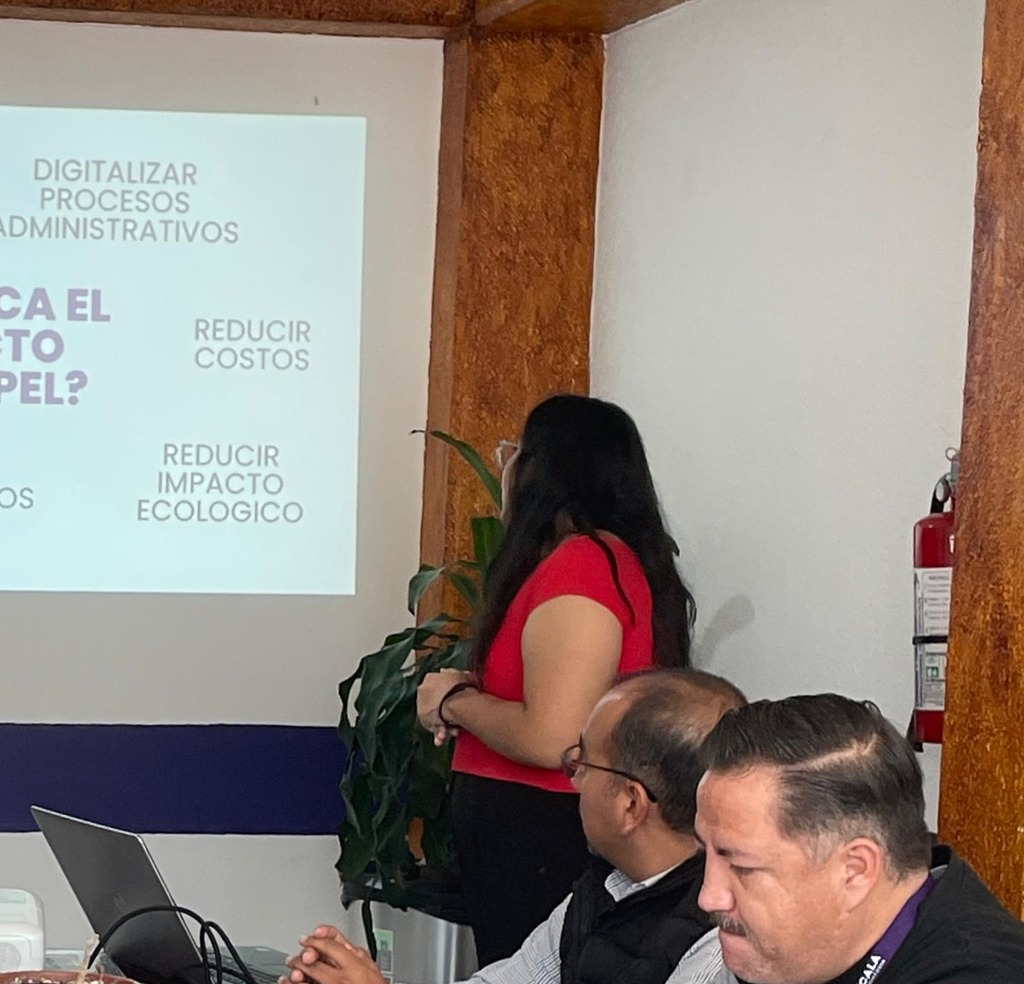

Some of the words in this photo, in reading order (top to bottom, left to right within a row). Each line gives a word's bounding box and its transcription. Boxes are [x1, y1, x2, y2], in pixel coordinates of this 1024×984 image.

[33, 158, 198, 186] DIGITALIZAR
[39, 187, 191, 214] PROCESOS
[67, 288, 111, 322] EL
[194, 319, 311, 343] REDUCIR
[194, 347, 310, 371] COSTOS
[163, 443, 279, 467] REDUCIR
[157, 471, 284, 495] IMPACTO
[136, 499, 304, 523] ECOLOGICO
